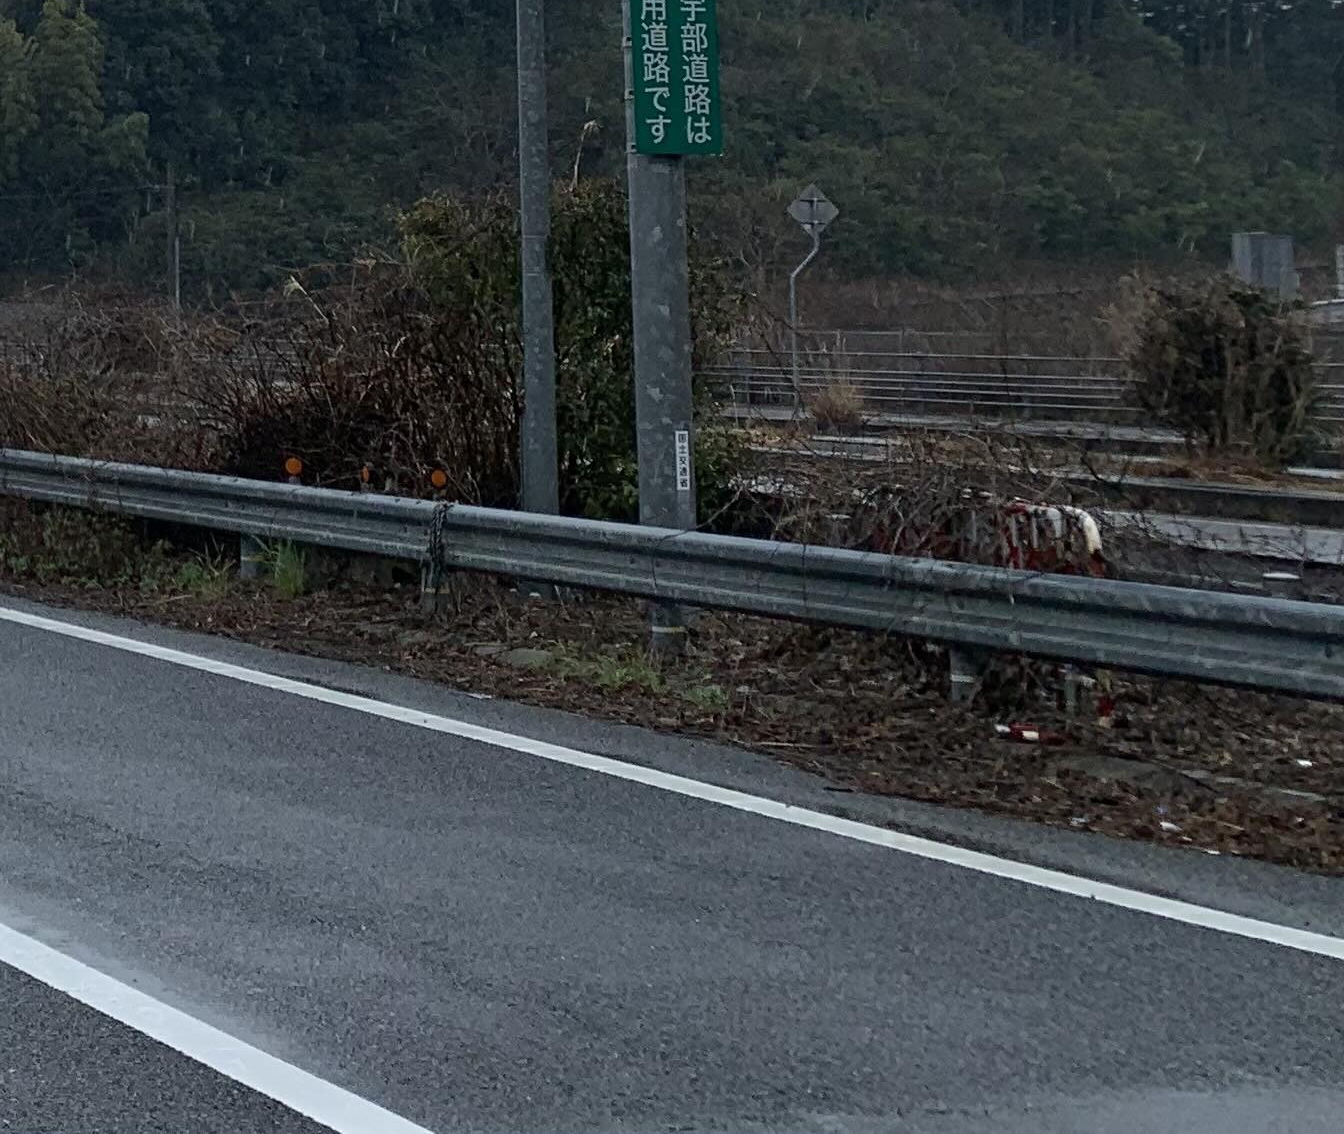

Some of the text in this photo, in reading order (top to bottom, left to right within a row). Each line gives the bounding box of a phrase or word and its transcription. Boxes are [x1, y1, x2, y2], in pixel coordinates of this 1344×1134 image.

[678, 433, 688, 488] 国土交通省
